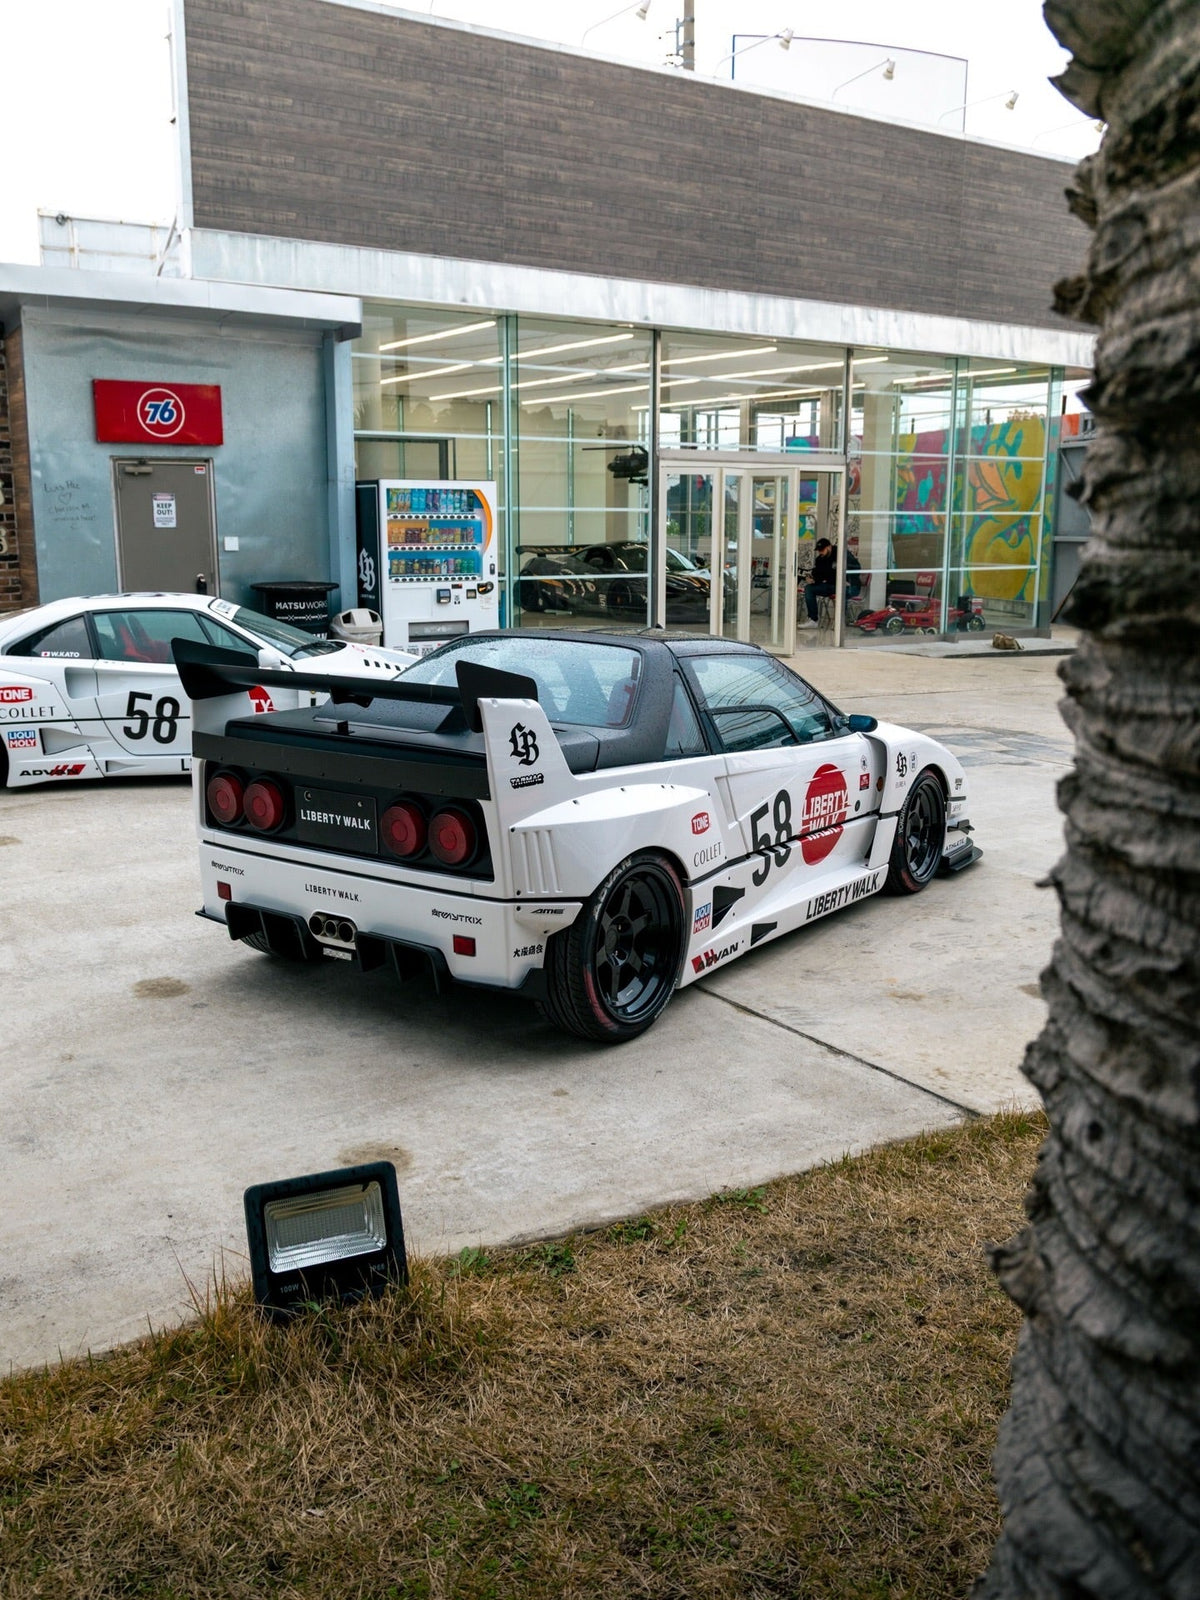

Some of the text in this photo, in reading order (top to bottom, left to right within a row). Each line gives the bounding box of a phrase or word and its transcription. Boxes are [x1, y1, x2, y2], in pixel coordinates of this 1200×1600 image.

[144, 398, 177, 425] 76
[0, 689, 30, 700] TONE
[123, 691, 181, 744] 58
[9, 731, 35, 740] LIQUI
[9, 739, 36, 748] MOLY
[19, 768, 80, 777] ADVAN
[801, 790, 849, 820] LIBERTY
[300, 809, 371, 830] LIBERTY WALK
[692, 814, 709, 832] TONE
[806, 812, 840, 840] WALK
[750, 789, 792, 887] 58
[693, 842, 721, 867] COLLET
[304, 884, 337, 897] LIBERTY
[806, 872, 880, 920] LIBERTY WALK
[696, 942, 739, 974] ADVAN
[280, 1283, 300, 1294] 100W
